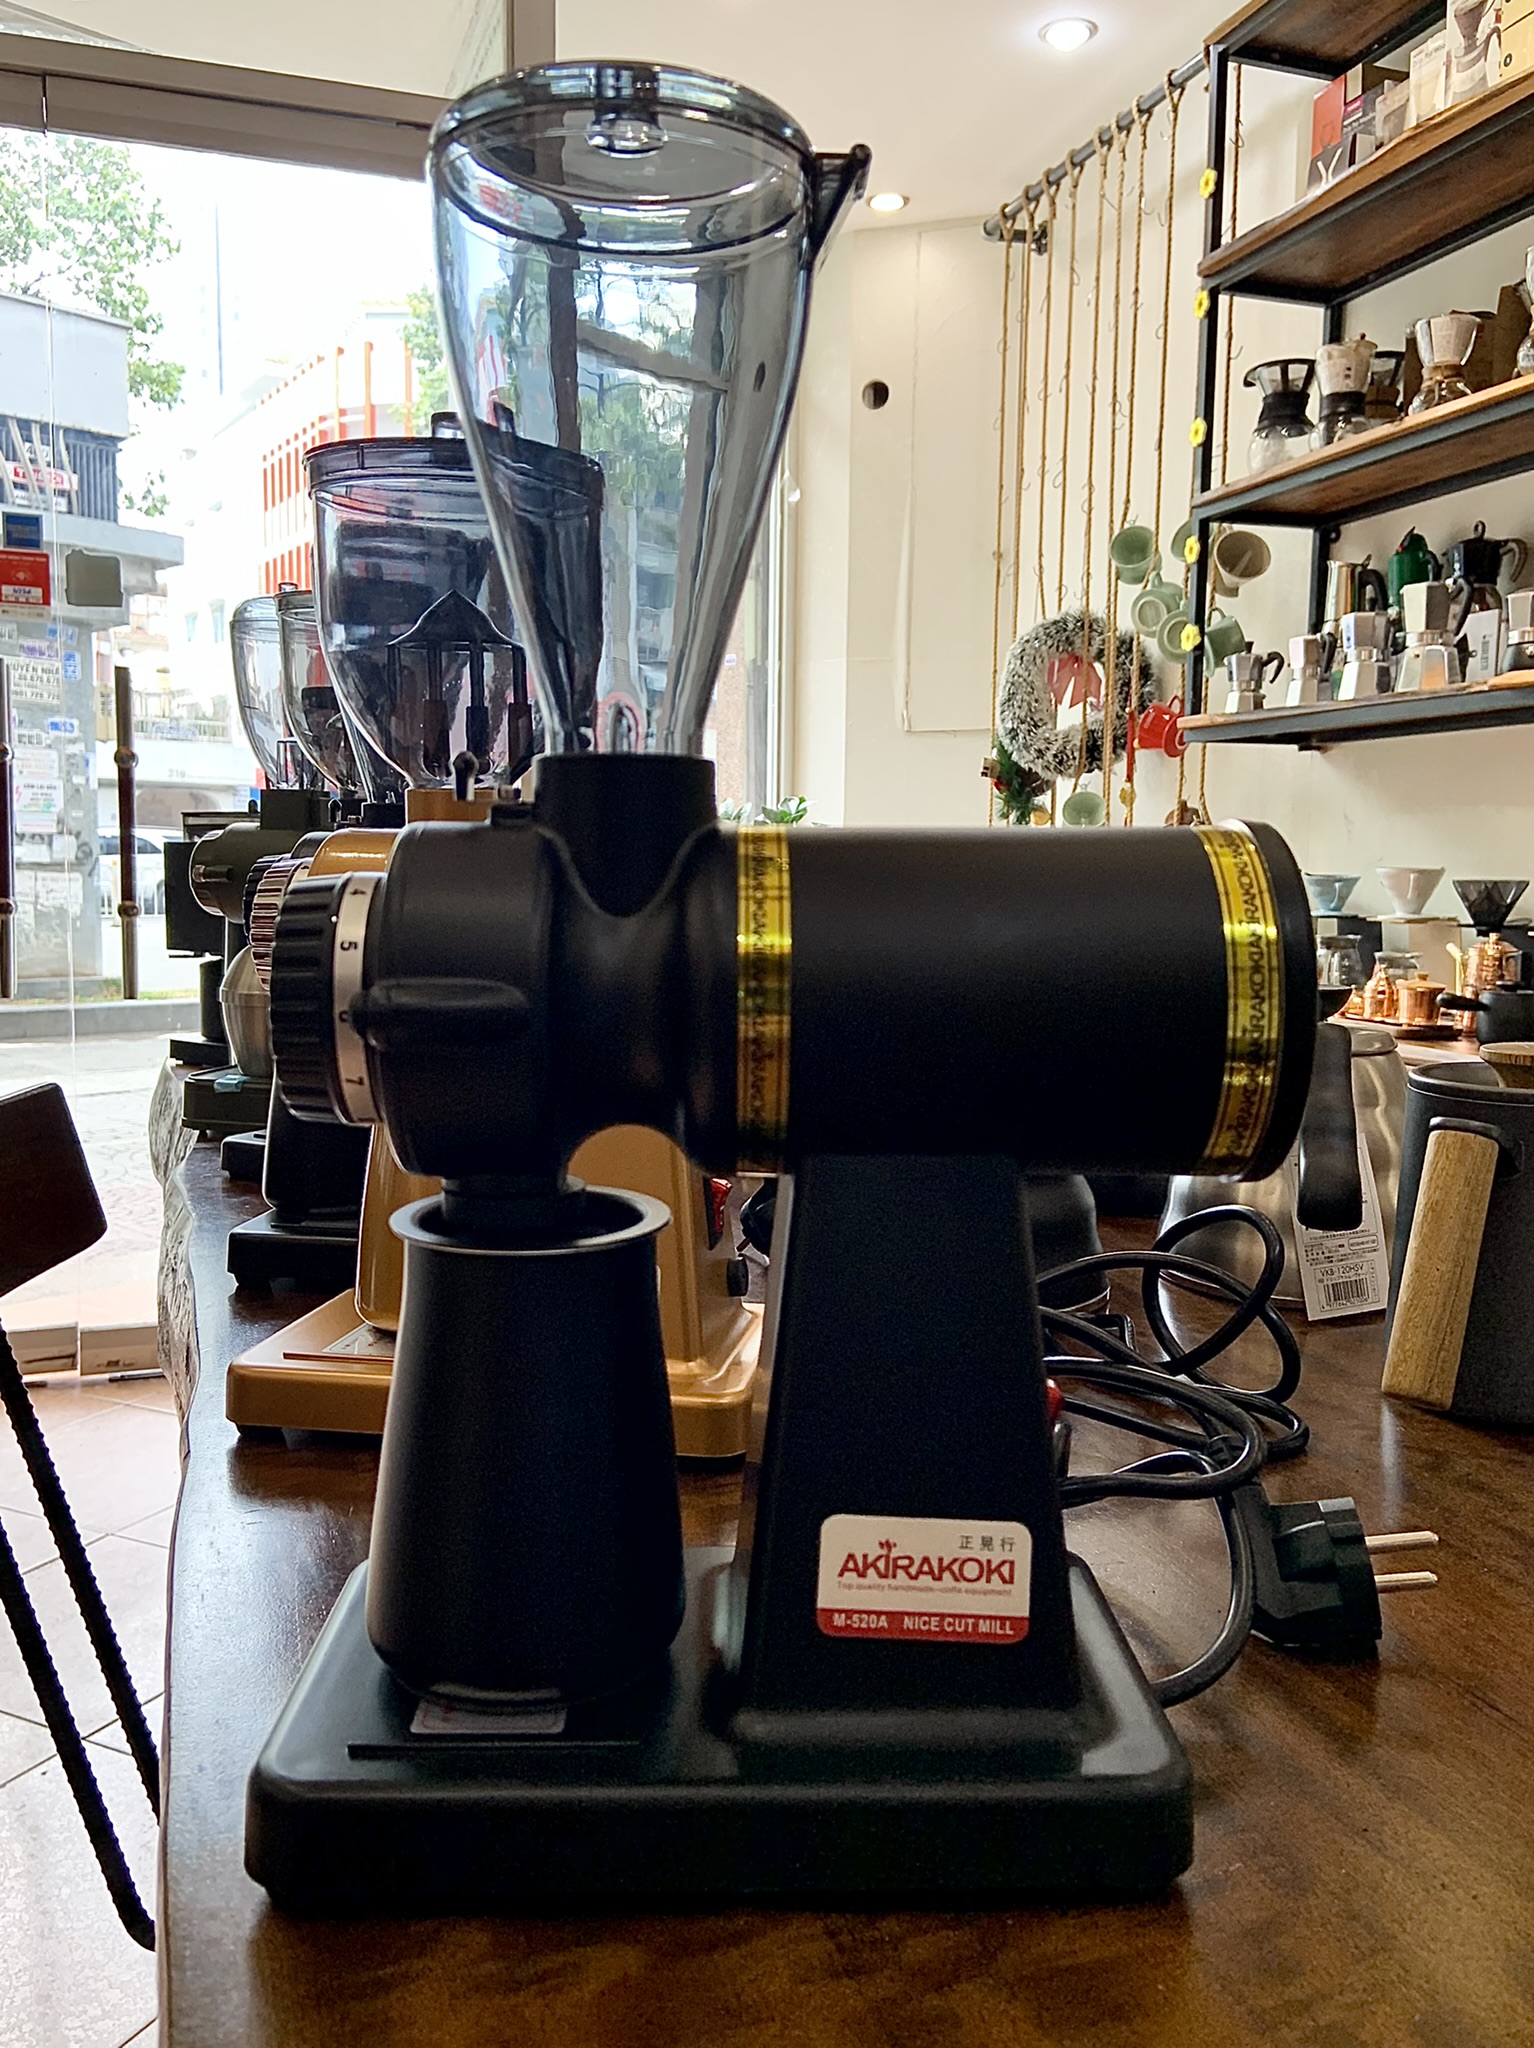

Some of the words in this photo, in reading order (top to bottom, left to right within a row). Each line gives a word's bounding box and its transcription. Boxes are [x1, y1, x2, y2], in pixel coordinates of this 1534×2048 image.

[341, 941, 357, 951] 5
[345, 1076, 364, 1086] 7
[1320, 1264, 1364, 1276] VKB-120HSV
[837, 1540, 1015, 1584] AKIRAKOKI
[833, 1613, 888, 1629] M-520A
[904, 1615, 940, 1631] NICE
[944, 1617, 975, 1633] CUT
[979, 1619, 1014, 1635] MILL
